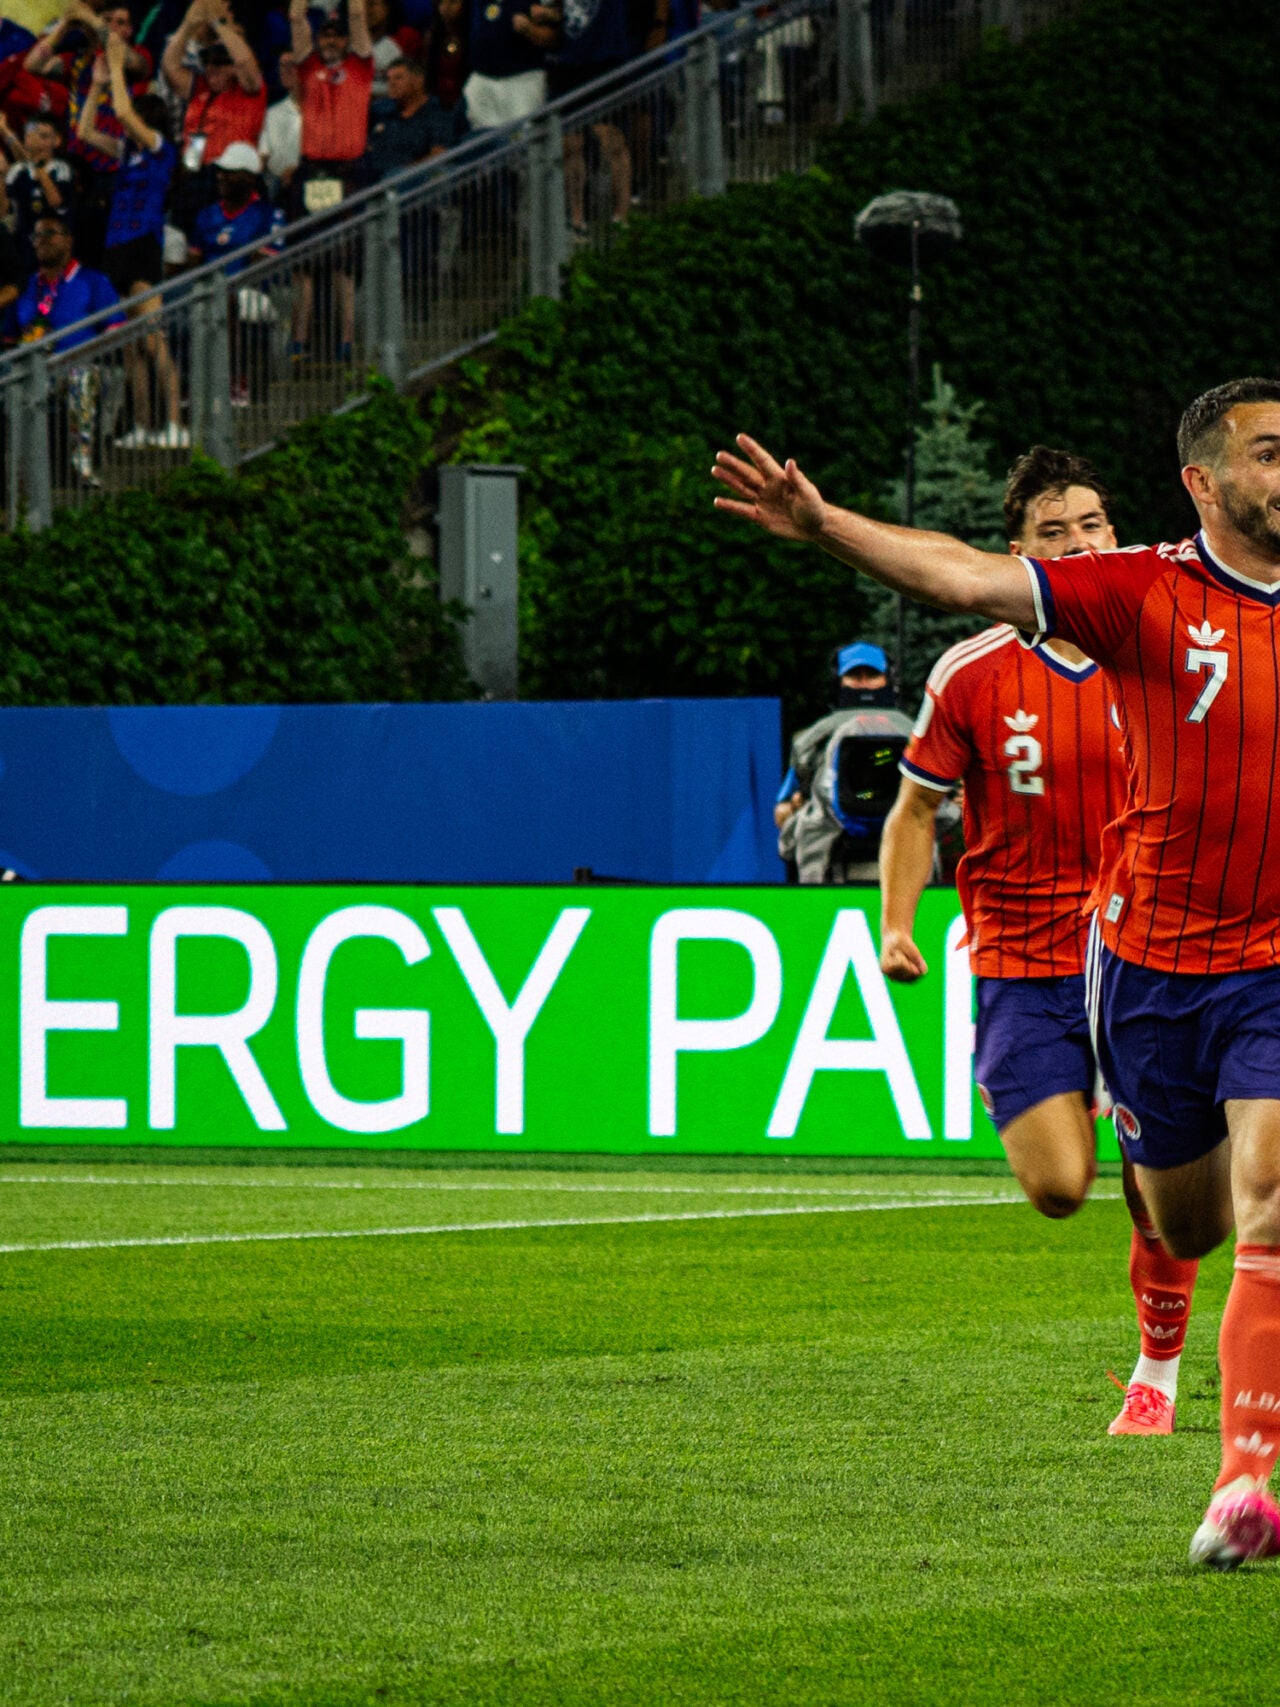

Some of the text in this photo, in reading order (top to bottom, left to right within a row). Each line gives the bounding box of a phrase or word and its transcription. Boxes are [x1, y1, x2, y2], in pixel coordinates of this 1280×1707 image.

[1184, 648, 1229, 724] 7
[1004, 735, 1045, 796] 2
[20, 904, 591, 1134] ERGY
[1141, 1292, 1186, 1310] ALBA
